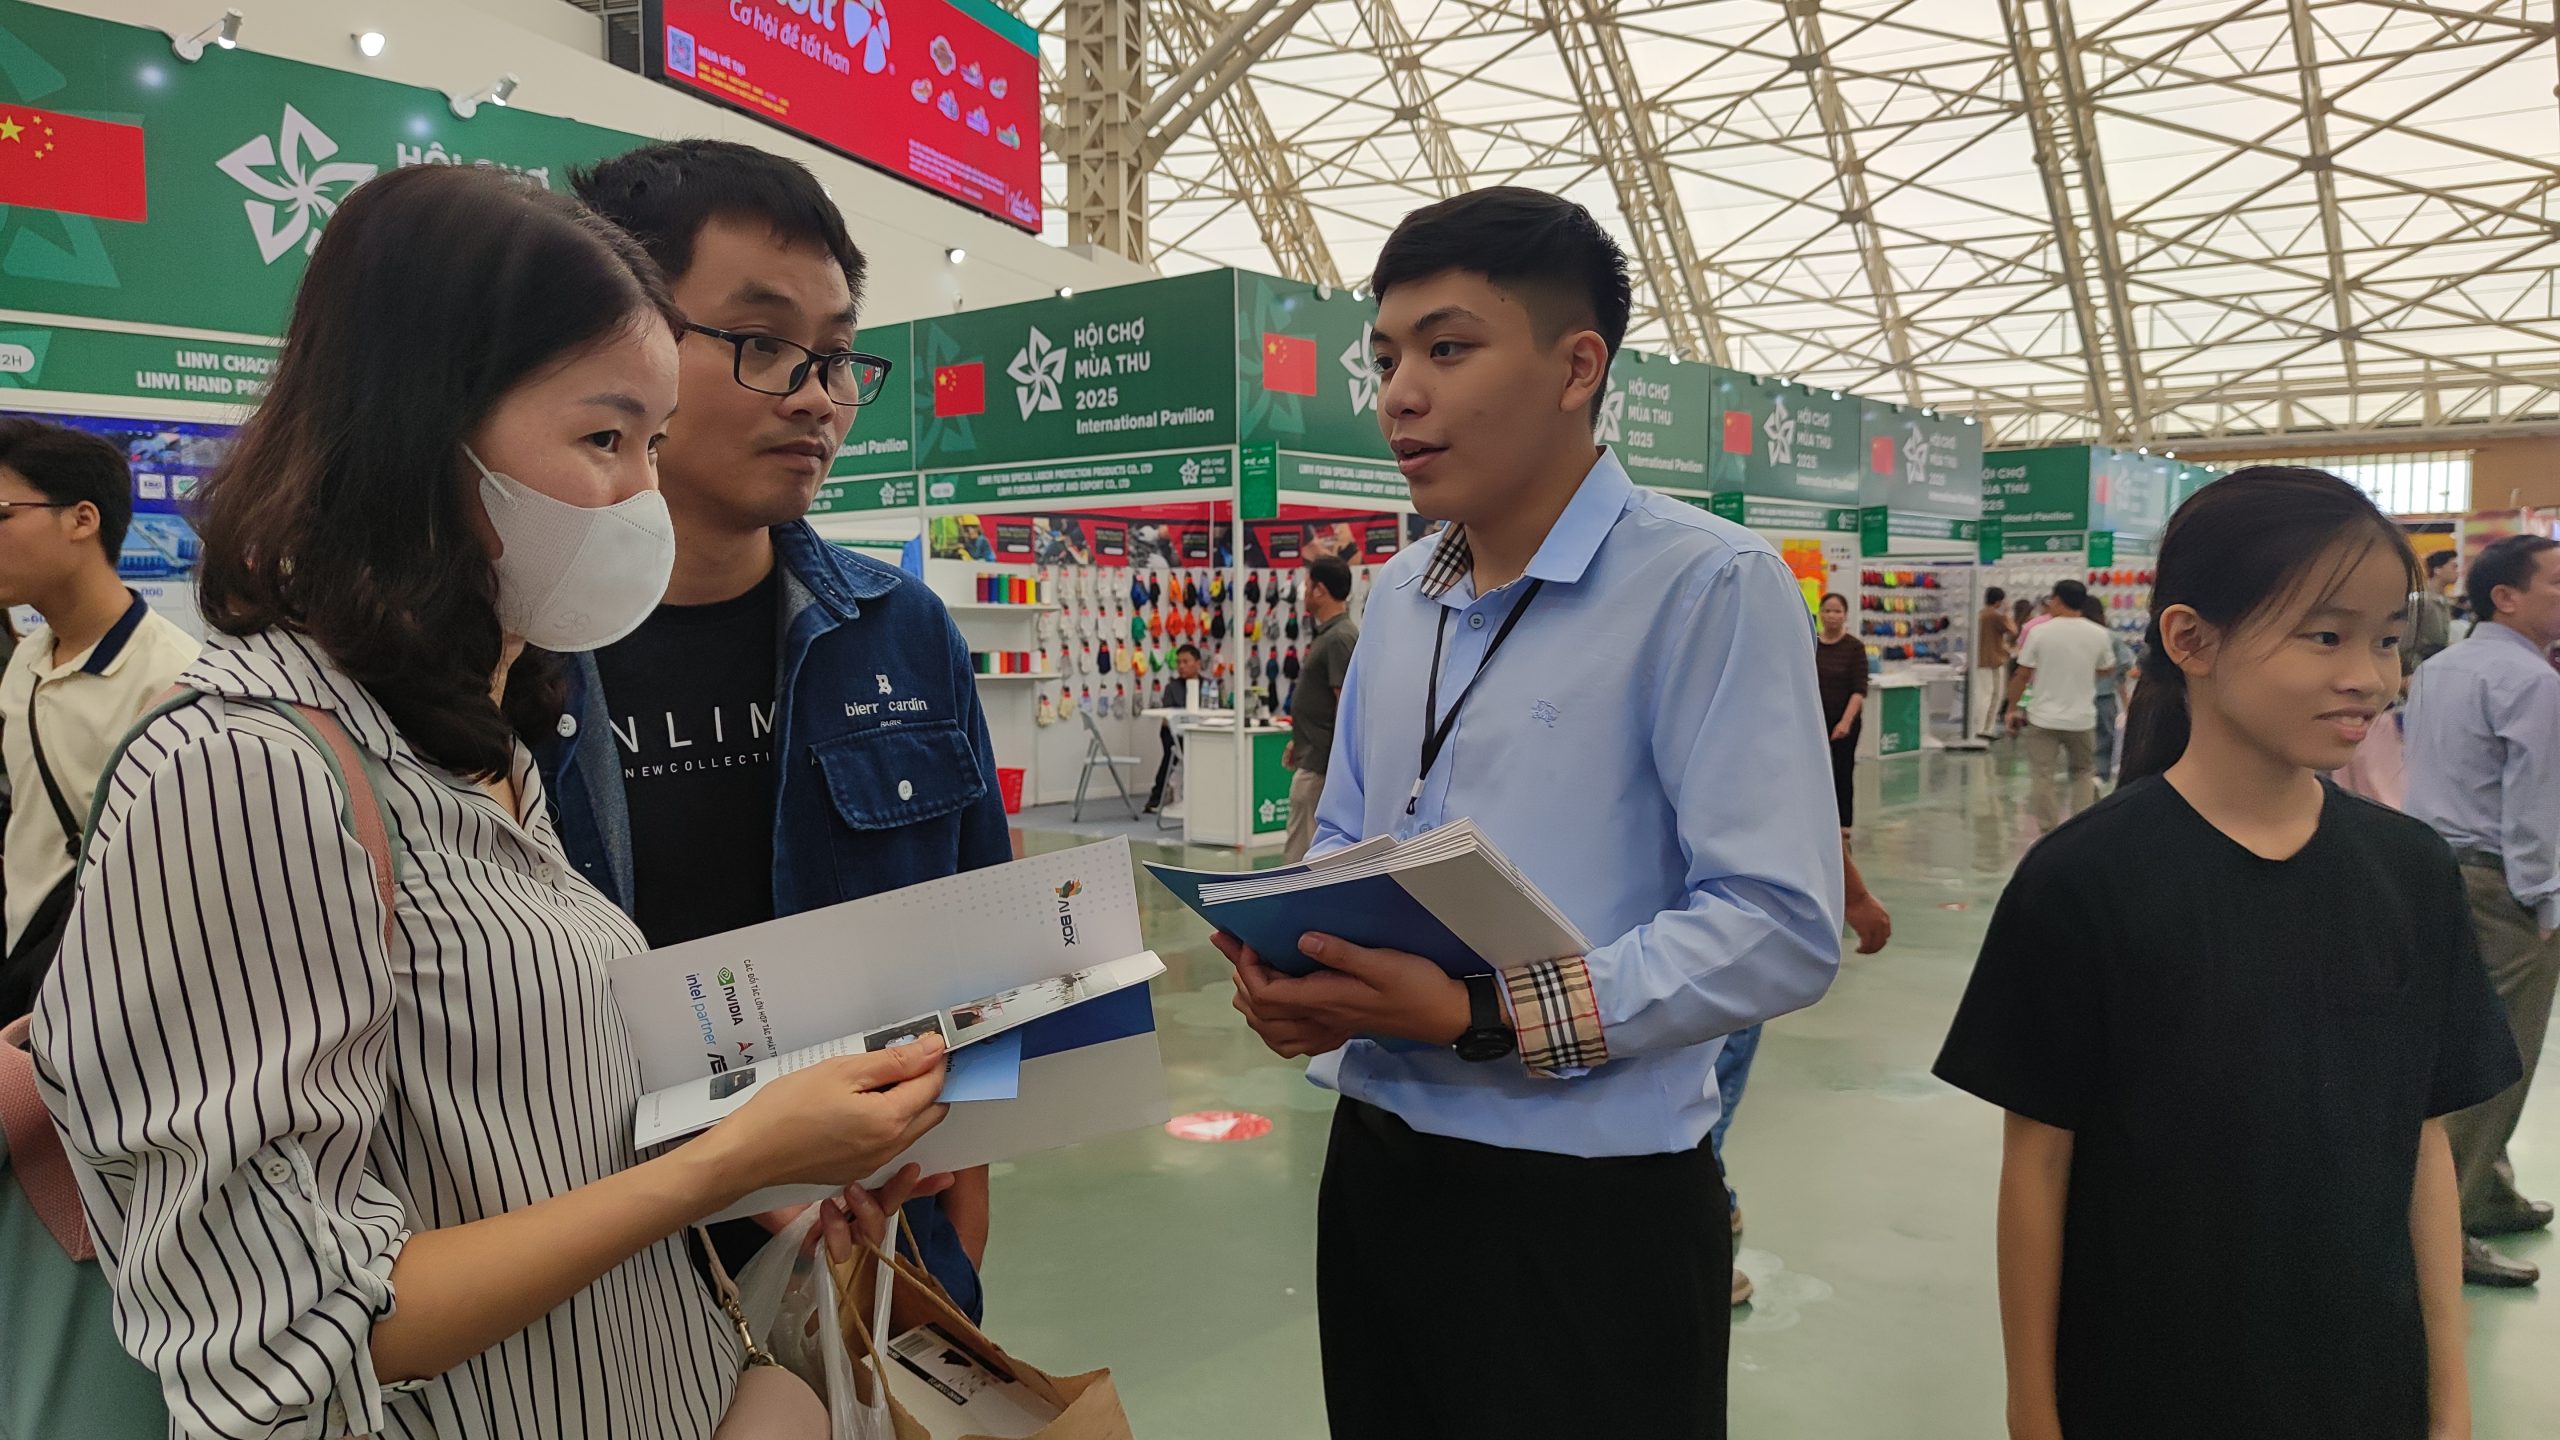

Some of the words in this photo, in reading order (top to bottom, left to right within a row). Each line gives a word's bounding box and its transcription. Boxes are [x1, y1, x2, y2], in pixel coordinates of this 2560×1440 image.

[730, 0, 753, 26] Cơ
[753, 6, 779, 41] hội
[801, 33, 821, 61] tốt
[823, 41, 850, 75] hơn
[1074, 321, 1104, 352] HỘI
[1107, 316, 1145, 346] CHỢ
[1075, 352, 1112, 379] MÙA
[1115, 351, 1151, 374] THU
[184, 374, 232, 394] HAND
[1075, 387, 1119, 410] 2025
[1076, 411, 1157, 435] International
[1160, 406, 1215, 427] Pavilion
[1652, 408, 1672, 426] THU
[868, 438, 908, 454] Pavilion
[1627, 430, 1654, 449] 2025
[844, 702, 879, 717] bierr
[609, 701, 776, 753] NLIM
[1060, 914, 1076, 948] BOX
[685, 973, 706, 1000] intel
[743, 959, 753, 973] CÁC
[751, 984, 760, 997] TÁC
[762, 1024, 772, 1036] TÁC
[690, 1002, 717, 1046] partner
